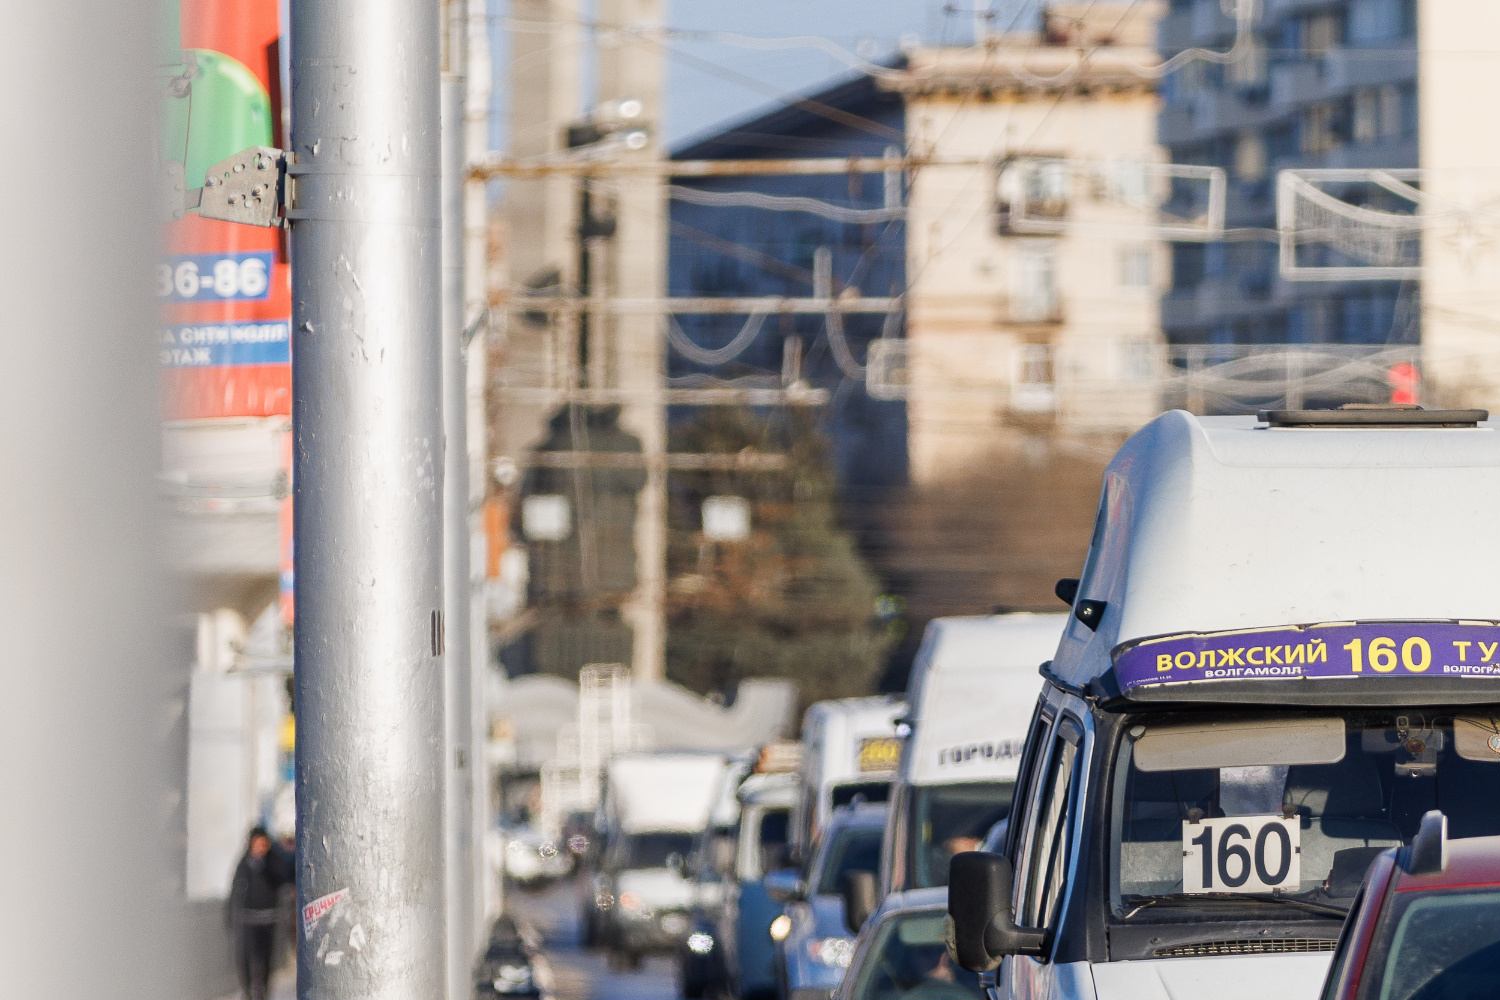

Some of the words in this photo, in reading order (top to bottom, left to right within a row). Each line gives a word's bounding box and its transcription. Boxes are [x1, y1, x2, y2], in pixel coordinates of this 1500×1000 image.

[1156, 638, 1328, 672] ВОЛЖСКИЙ
[1343, 636, 1432, 673] 160
[1205, 666, 1302, 678] ВОЛГАМОЛЛ
[1191, 822, 1292, 889] 160
